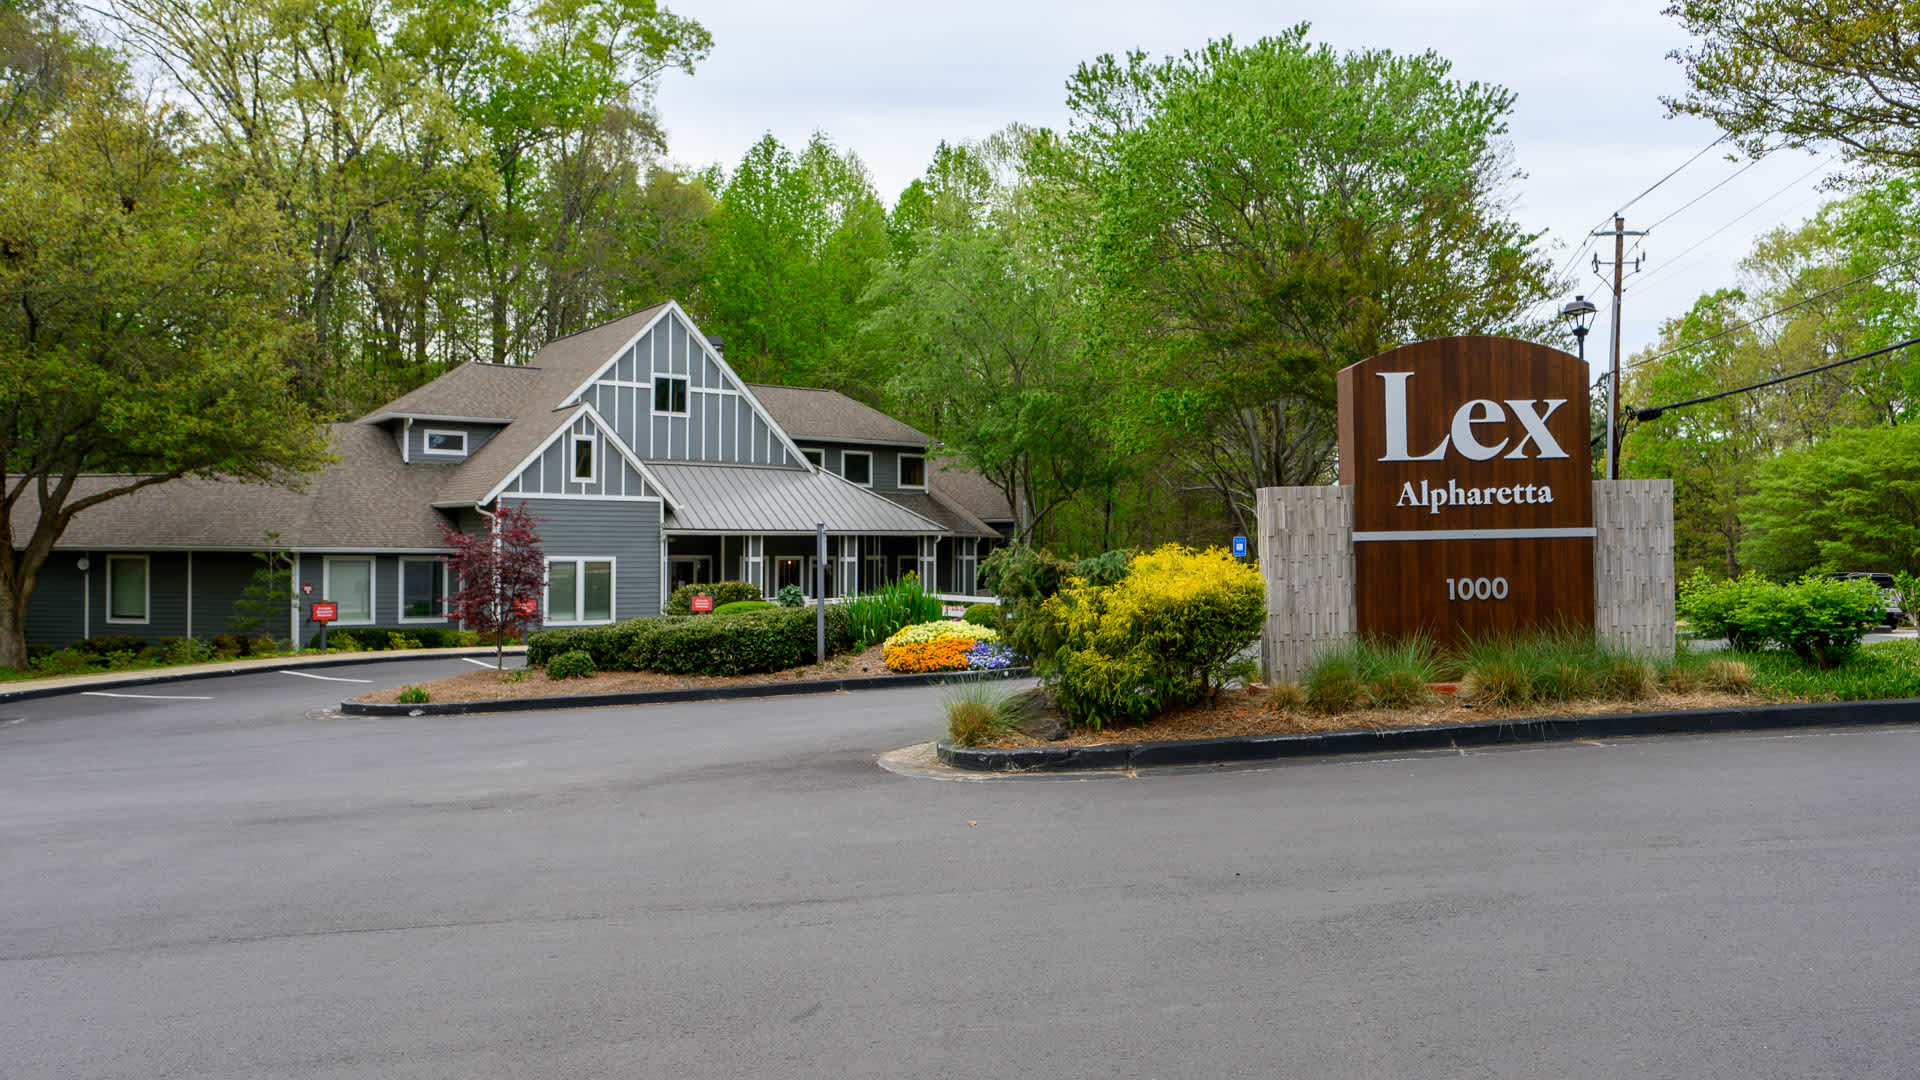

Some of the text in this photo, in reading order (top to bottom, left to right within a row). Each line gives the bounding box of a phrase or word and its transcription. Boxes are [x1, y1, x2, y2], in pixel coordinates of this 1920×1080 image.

[1376, 372, 1570, 462] Lex
[1396, 479, 1554, 514] Alpharetta
[1446, 577, 1509, 601] 1000
